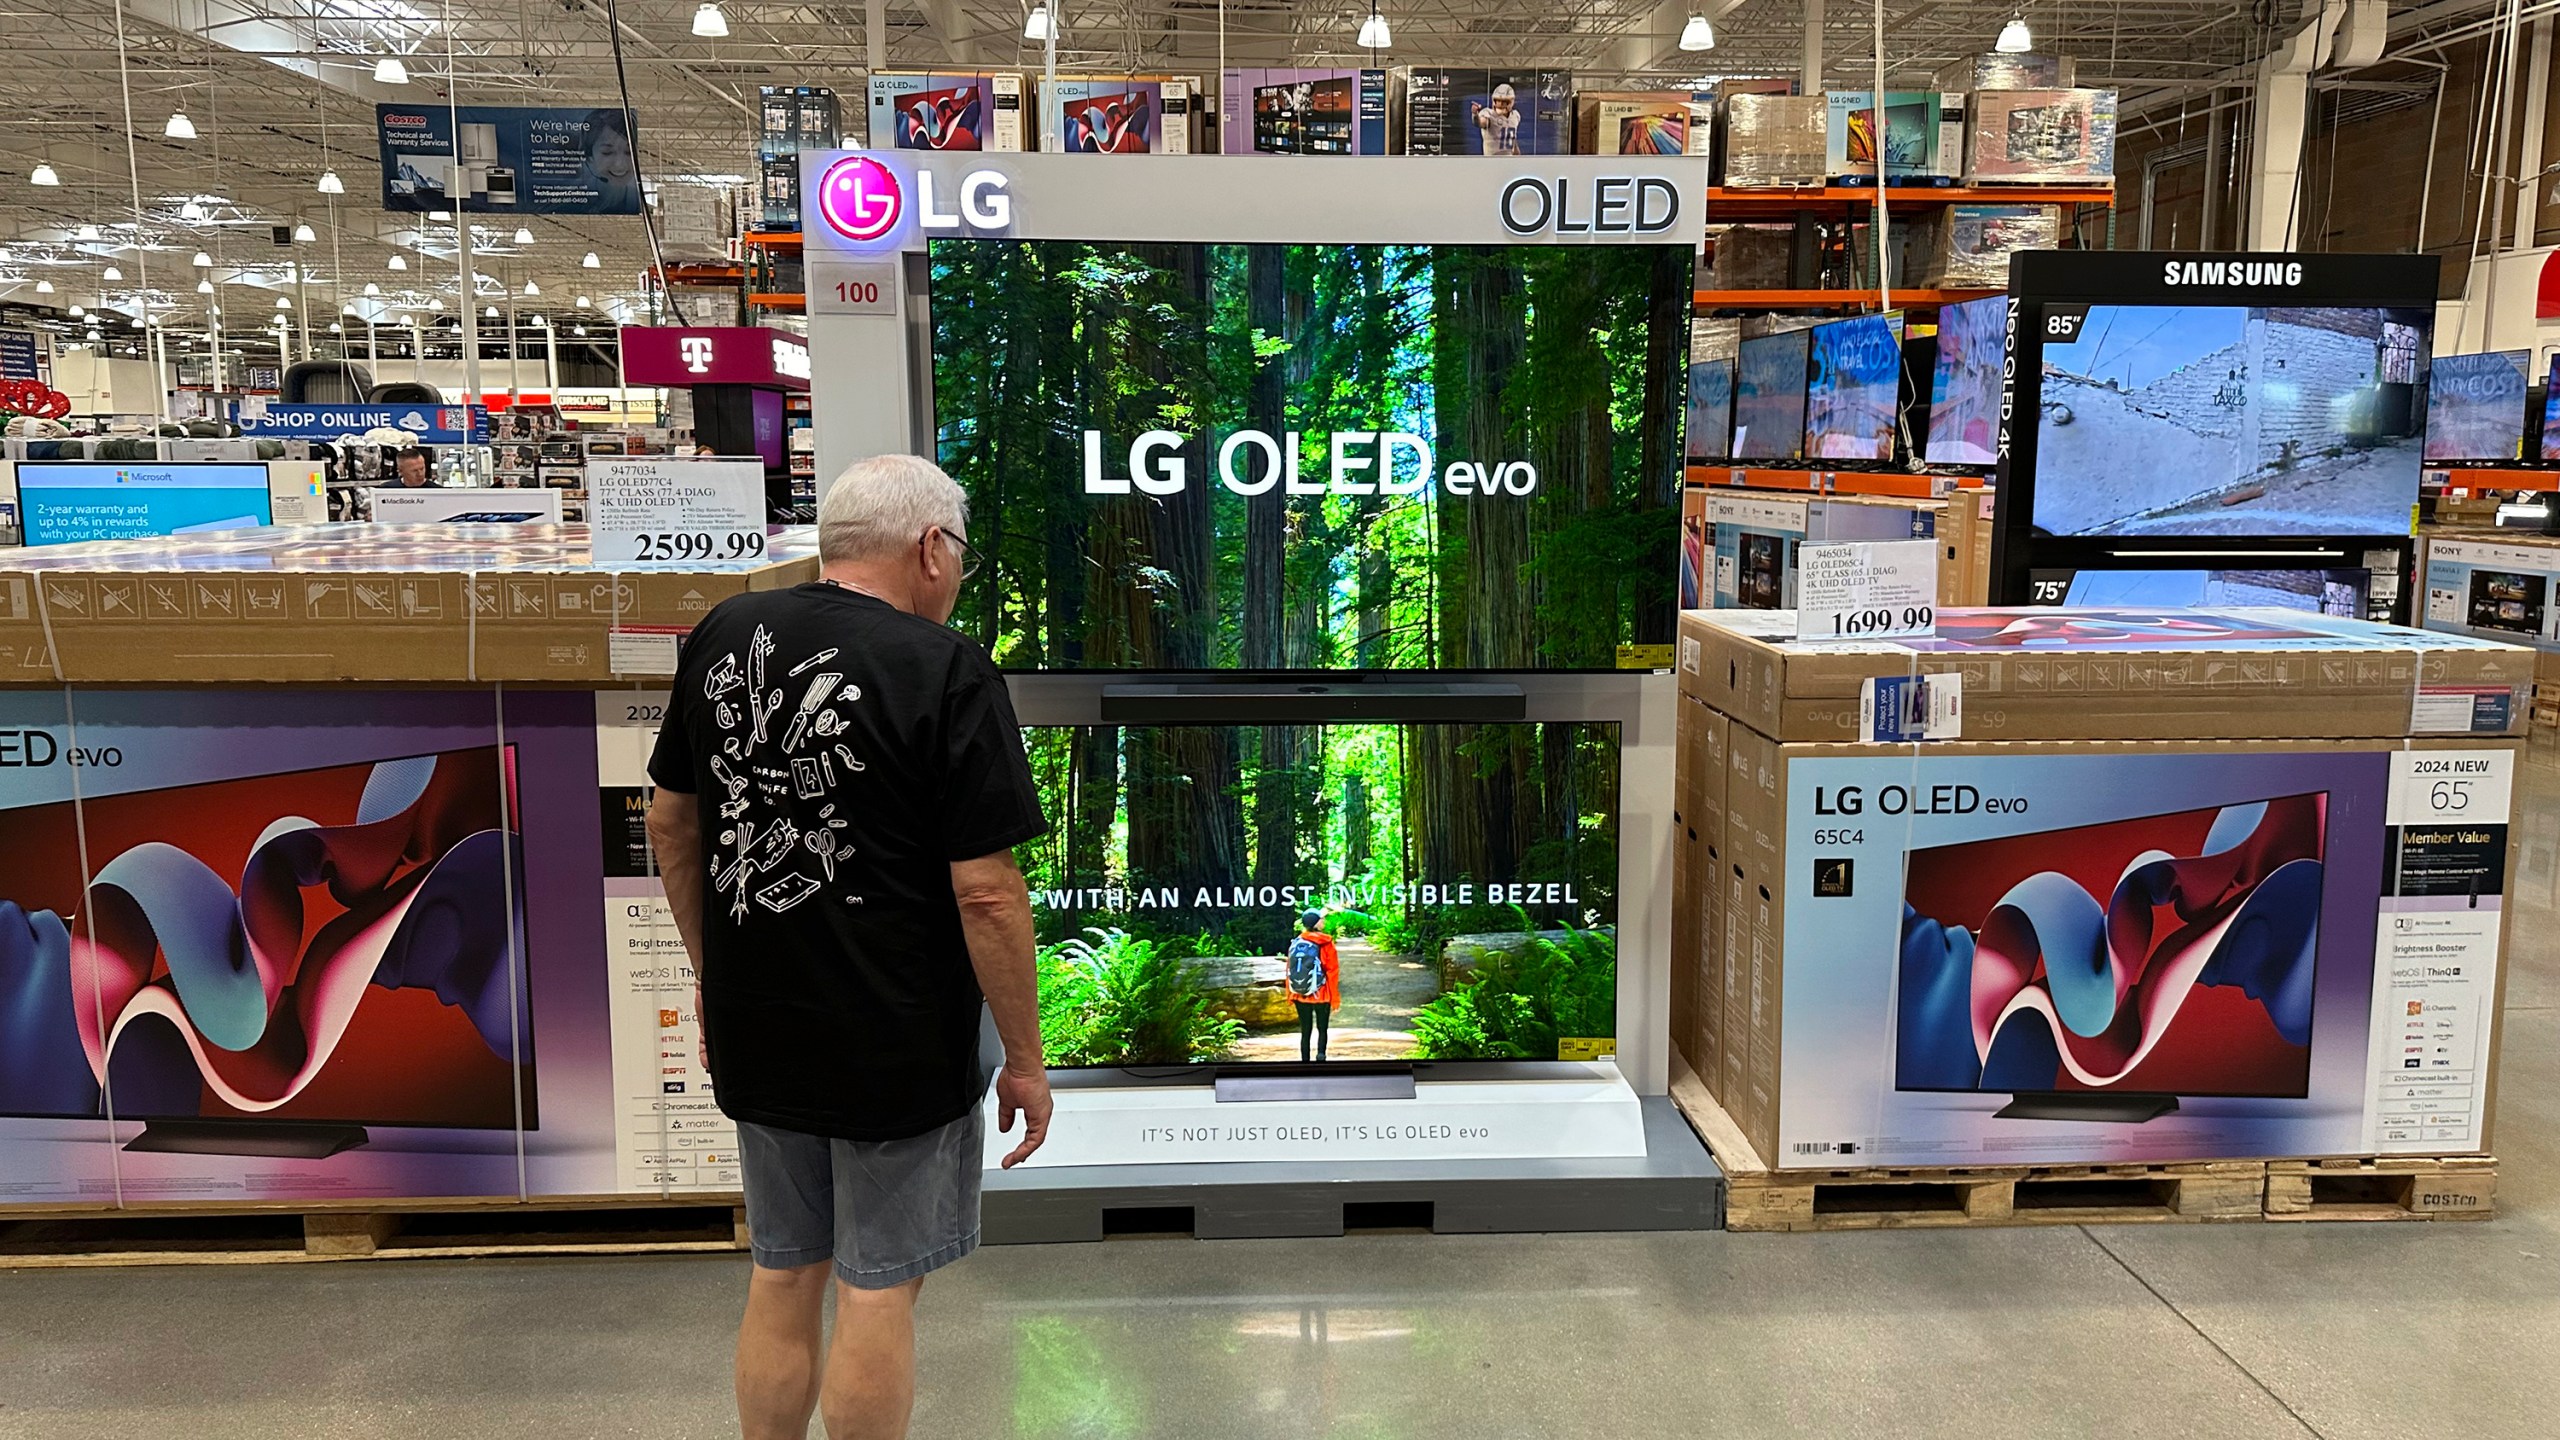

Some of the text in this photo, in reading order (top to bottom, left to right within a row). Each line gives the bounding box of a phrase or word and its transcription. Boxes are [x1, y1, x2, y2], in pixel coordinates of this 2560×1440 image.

[385, 114, 426, 124] COSTCO
[530, 120, 590, 131] We're here
[386, 131, 418, 139] Technical
[530, 133, 569, 145] to help
[387, 139, 418, 147] Warranty
[918, 170, 1010, 229] LG
[1501, 177, 1680, 234] OLED
[2165, 262, 2302, 286] SAMSUNG
[835, 282, 878, 302] 100
[2047, 315, 2081, 334] 85"
[680, 337, 713, 373] T
[1996, 298, 2019, 459] Neo QLED 4K
[559, 396, 609, 406] KIRKLAND
[2212, 394, 2247, 411] TAXCO
[264, 412, 391, 427] SHOP ONLINE
[1084, 429, 1537, 496] LG OLED evo
[131, 472, 173, 482] Microsoft
[611, 466, 656, 476] 9477034
[599, 477, 672, 487] LG OLED77C4
[599, 487, 715, 498] 77" CLASS (77.4 DIAG)
[386, 497, 424, 505] MacBook Air
[600, 498, 693, 507] 4K UHD OLED TV
[37, 503, 148, 516] 2-year warranty and
[1719, 505, 1734, 515] SONY
[39, 516, 149, 528] up to 4% in rewards
[40, 529, 159, 541] with your PC purchase
[634, 532, 764, 561] 2599.99
[2434, 545, 2462, 556] SONY
[1817, 548, 1852, 559] 9465034
[1806, 558, 1863, 570] LG OLED65C4
[1806, 566, 1897, 579] 65" CLASS DIAG)
[1806, 577, 1880, 588] 4K UHD OLED TV
[2034, 581, 2066, 600] 75"
[1832, 606, 1933, 637] 1699.99
[1888, 685, 1896, 717] television
[627, 705, 666, 721] 202
[1878, 689, 1888, 731] Protect your
[0, 730, 122, 767] ED evo
[1740, 756, 1748, 772] LG
[2414, 760, 2490, 773] 2024 NEW
[752, 765, 790, 779] CARBON
[1766, 770, 1775, 789] LG
[757, 781, 788, 795] KNIFE
[1814, 785, 2028, 815] LG OLED evo
[2431, 780, 2473, 810] 65"
[1814, 829, 1864, 845] 65C4
[2403, 831, 2490, 845] Member Value
[1044, 883, 1579, 909] WITH AN ALMOST INVISIBLE BEZEL
[2393, 944, 2466, 953] Brightness Booster
[630, 967, 670, 978] webOS
[2427, 967, 2451, 977] ThinQ
[664, 1014, 676, 1023] CH
[686, 1120, 719, 1128] matter
[1142, 1125, 1489, 1142] IT'S NOT JUST OLED, IT'S LG OLED evo
[2423, 1193, 2477, 1206] COSTCO
